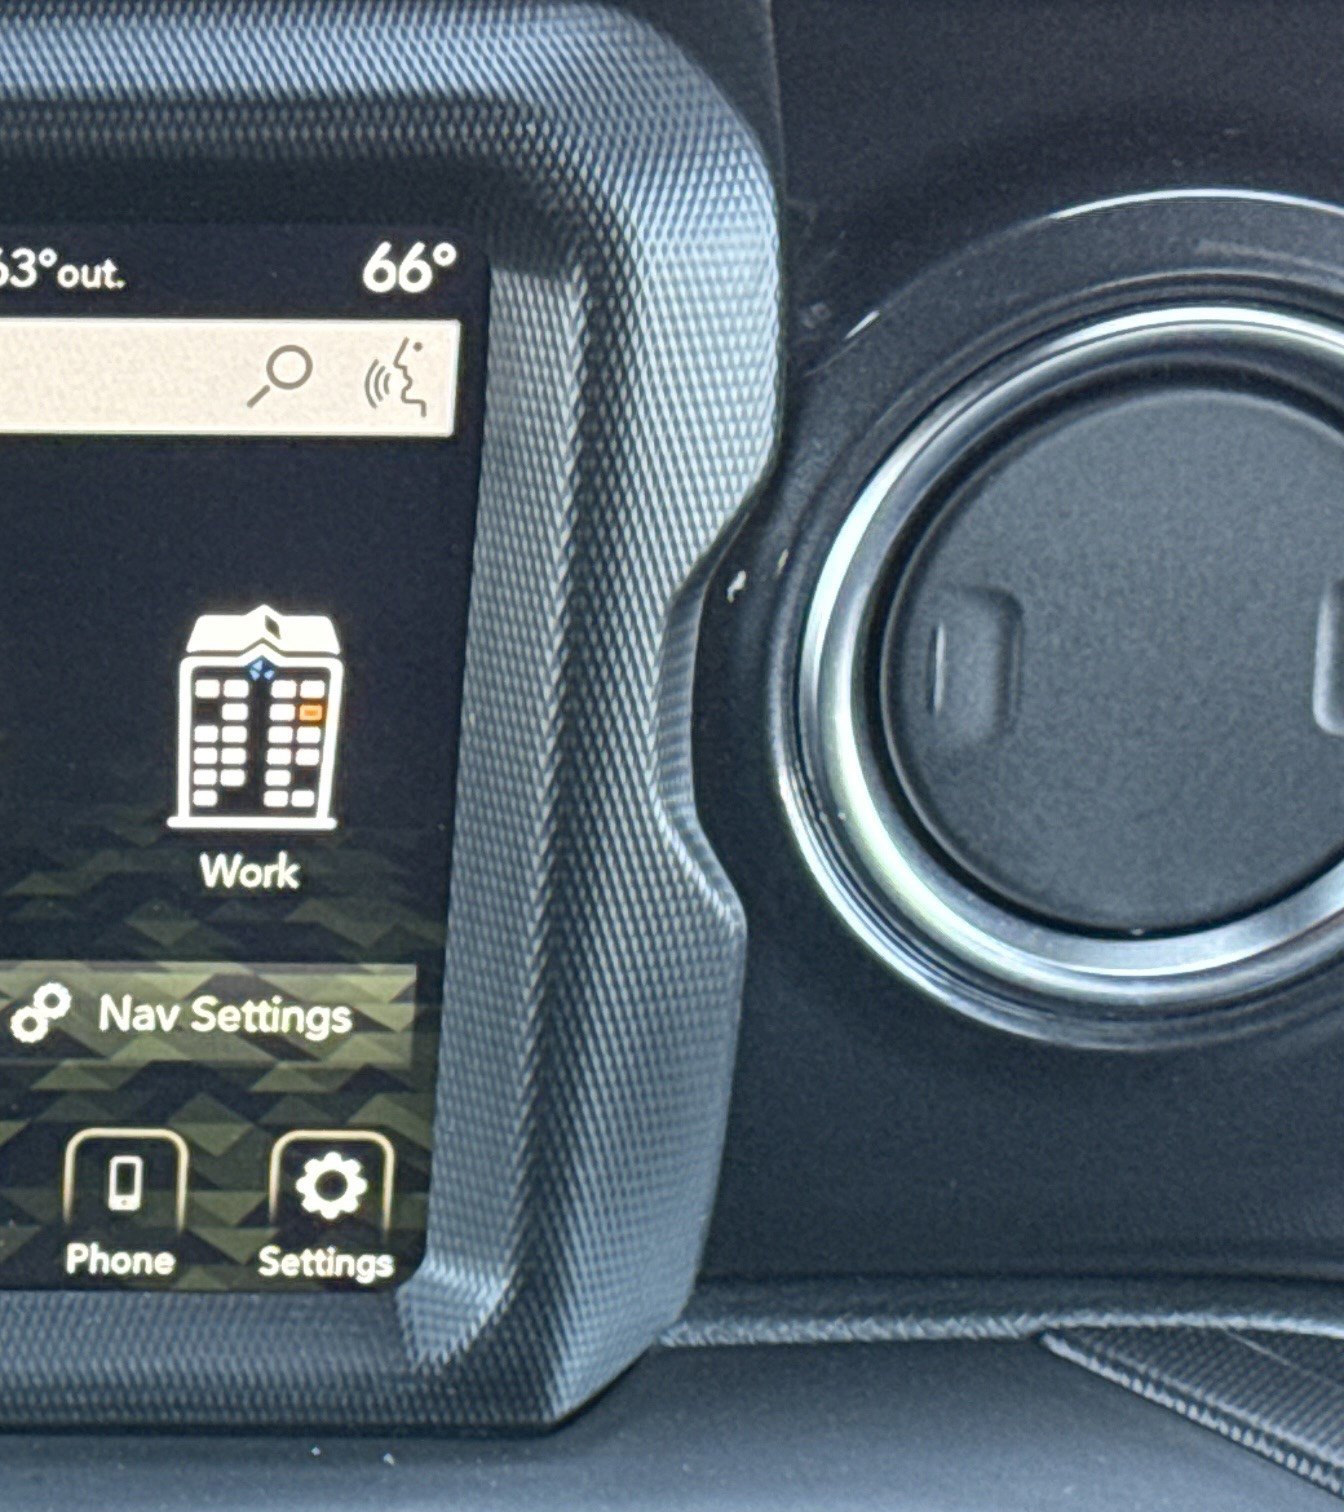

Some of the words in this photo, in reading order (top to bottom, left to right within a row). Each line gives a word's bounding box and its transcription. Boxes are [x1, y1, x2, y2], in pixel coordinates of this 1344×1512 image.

[361, 240, 458, 295] 66°
[198, 849, 302, 891] Work
[97, 992, 183, 1033] Nav
[189, 993, 354, 1043] Settings
[65, 1240, 178, 1276] Phone
[256, 1244, 396, 1286] Settings
